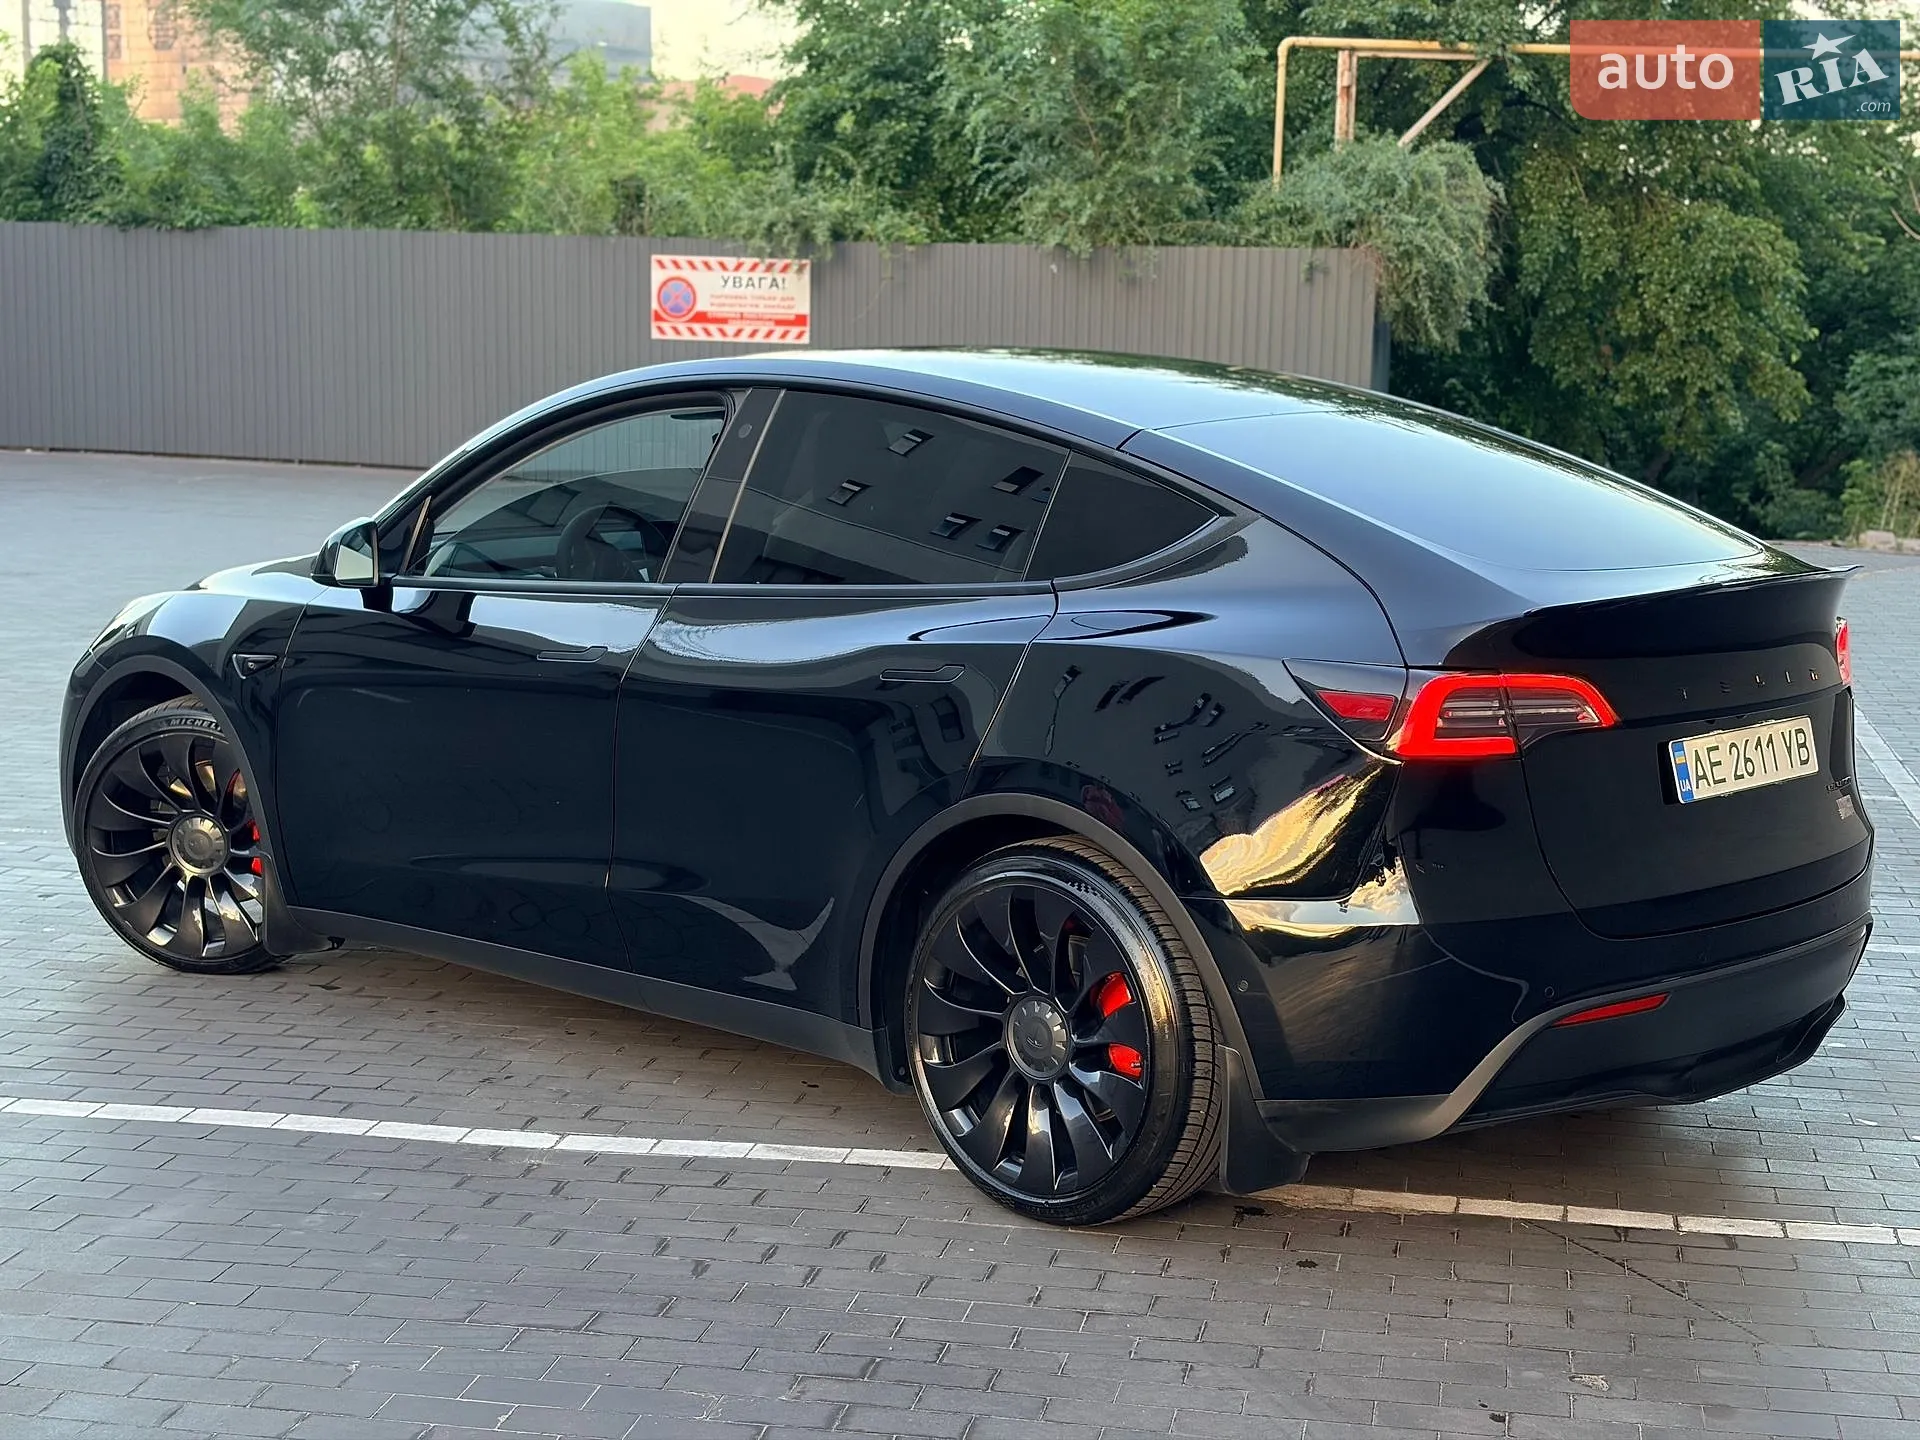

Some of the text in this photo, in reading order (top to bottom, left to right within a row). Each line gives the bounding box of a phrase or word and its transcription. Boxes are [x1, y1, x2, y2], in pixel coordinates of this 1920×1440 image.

[721, 275, 787, 290] УВАГА!
[170, 718, 221, 731] MICHEL
[1692, 727, 1811, 789] AE 2611 YB
[1680, 779, 1692, 792] UA
